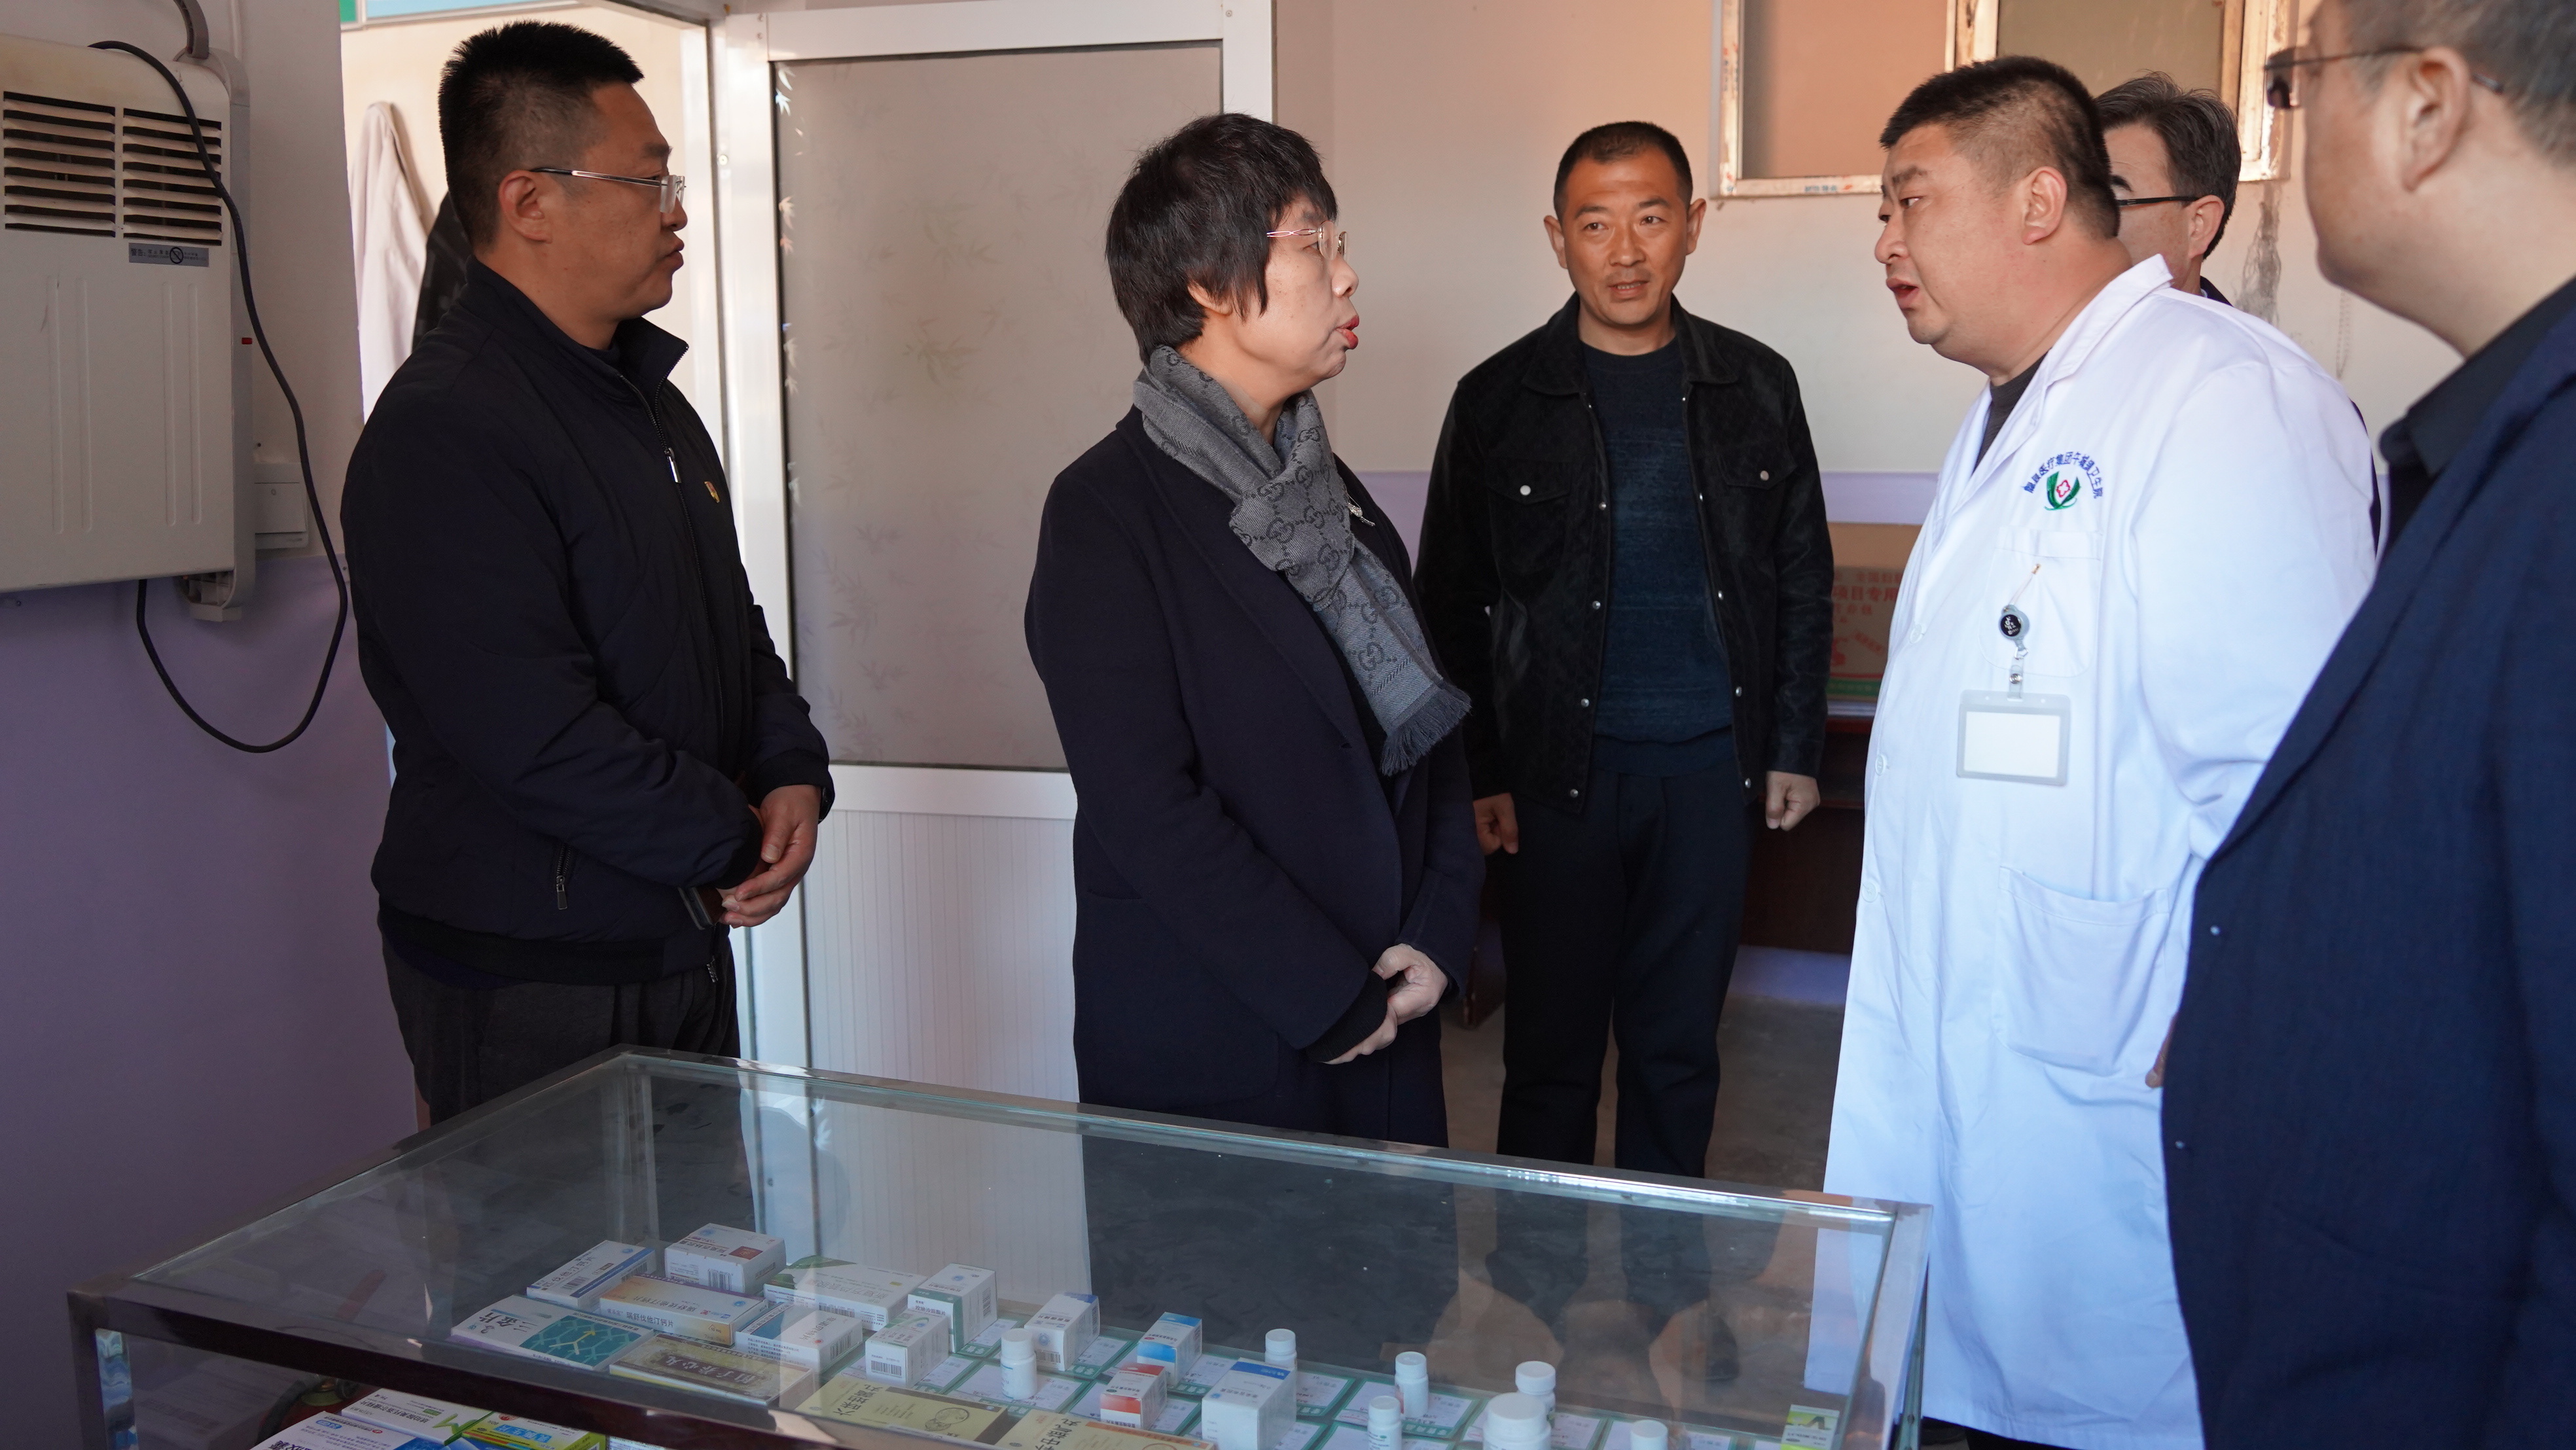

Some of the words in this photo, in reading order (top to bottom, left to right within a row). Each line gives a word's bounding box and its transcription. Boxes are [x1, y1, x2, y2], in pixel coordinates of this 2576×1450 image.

[479, 1312, 539, 1332] 三金片
[626, 1311, 674, 1328] 瑞舒伐他汀钙片
[833, 1383, 884, 1419] 六味地黄丸
